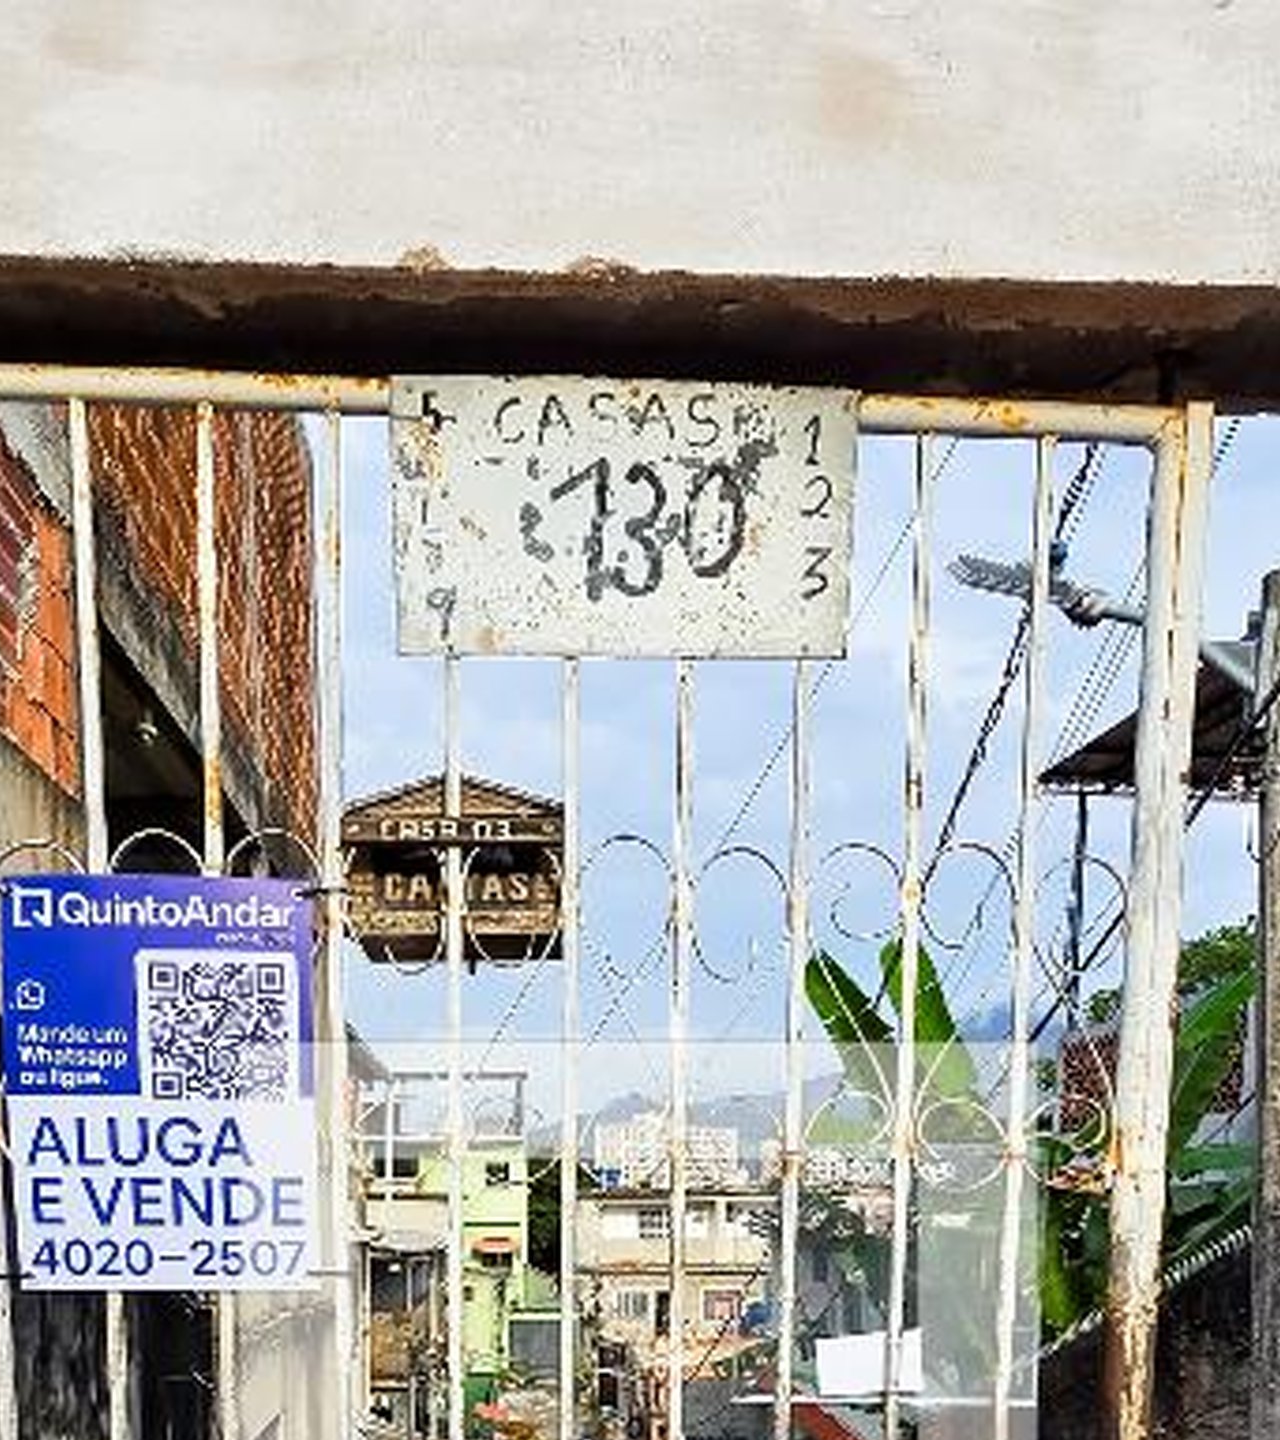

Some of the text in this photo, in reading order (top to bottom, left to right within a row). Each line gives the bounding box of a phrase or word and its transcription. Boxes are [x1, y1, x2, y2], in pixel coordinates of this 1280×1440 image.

[494, 393, 721, 448] CASAS
[805, 415, 821, 466] 1
[801, 475, 833, 519] 2
[550, 457, 746, 603] 130
[803, 546, 829, 600] 3
[380, 820, 458, 840] CASA
[58, 892, 294, 926] QuintoAndar
[384, 873, 530, 902] CAAS
[17, 1023, 128, 1044] Mande um
[20, 1071, 48, 1085] ou
[28, 1116, 253, 1167] ALUGA
[31, 1176, 304, 1226] E VENDE
[32, 1239, 307, 1277] 4020-2507
